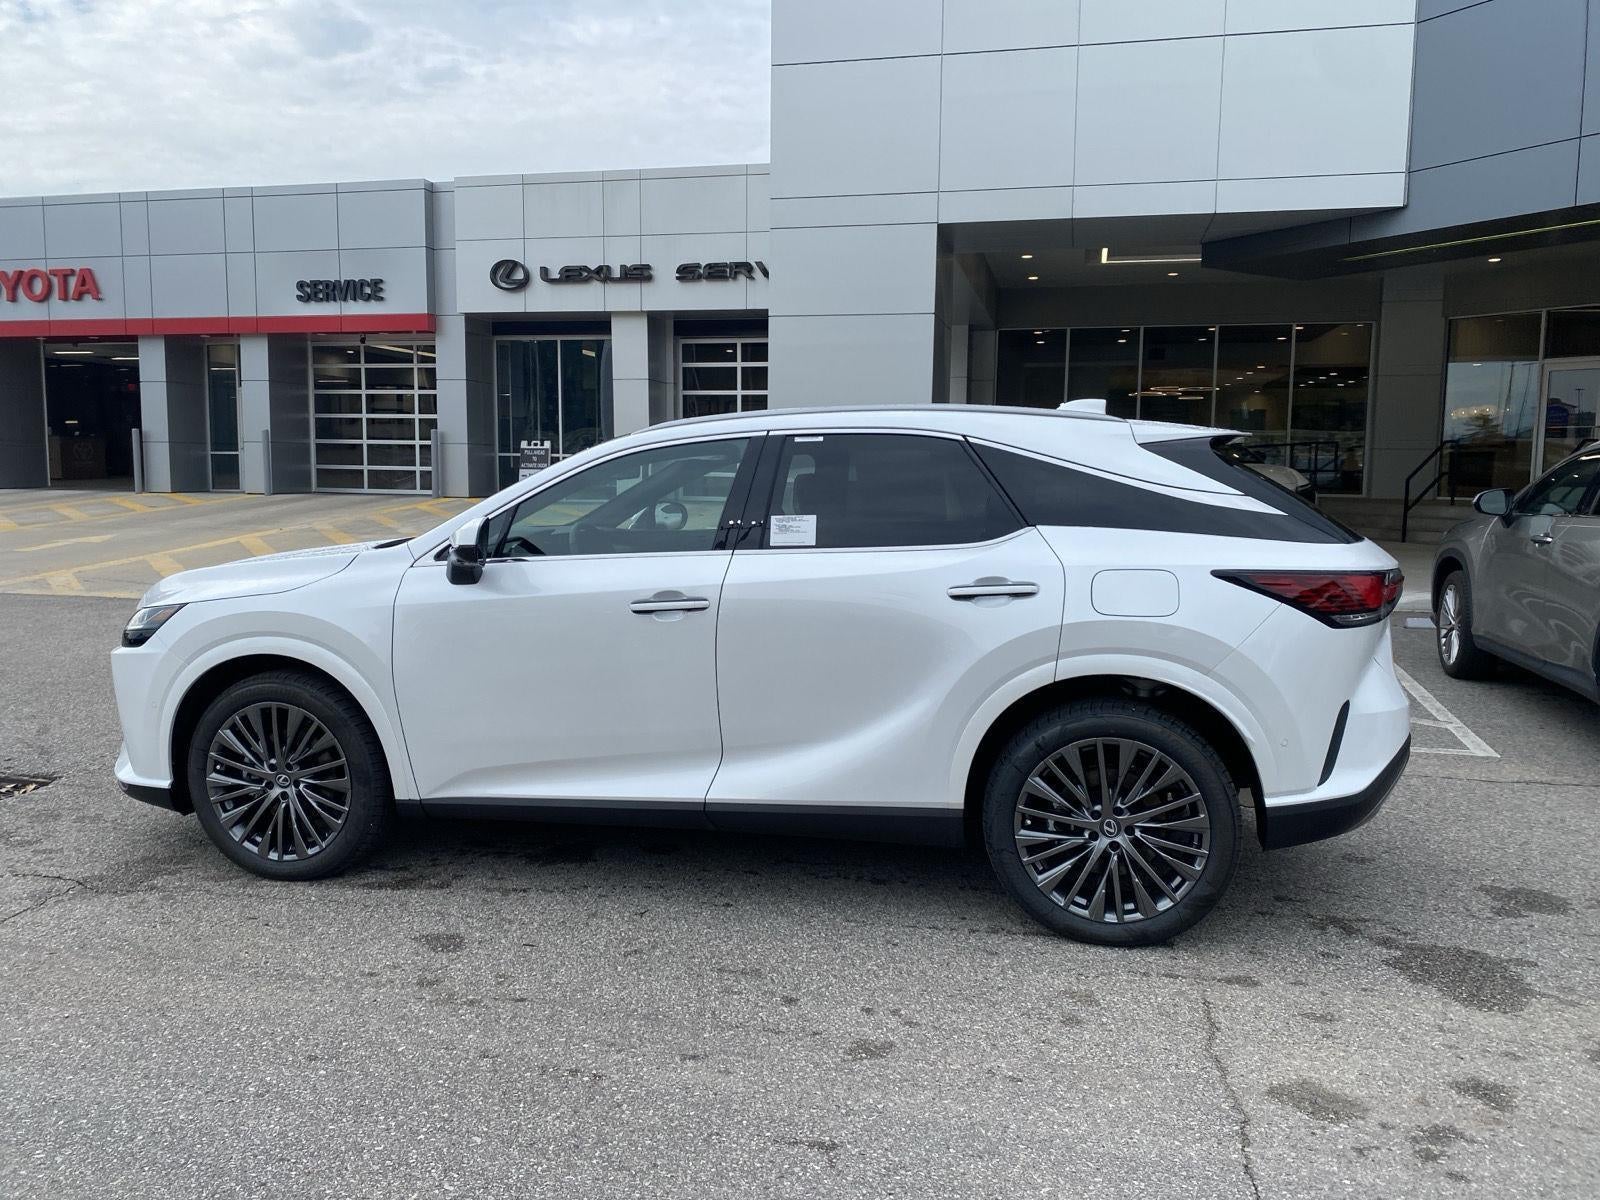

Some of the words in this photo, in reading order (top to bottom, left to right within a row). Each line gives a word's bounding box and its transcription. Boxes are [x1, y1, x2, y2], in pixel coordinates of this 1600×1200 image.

[0, 267, 103, 303] YOTA
[540, 264, 653, 283] LEXUS
[296, 278, 385, 303] SERVICE
